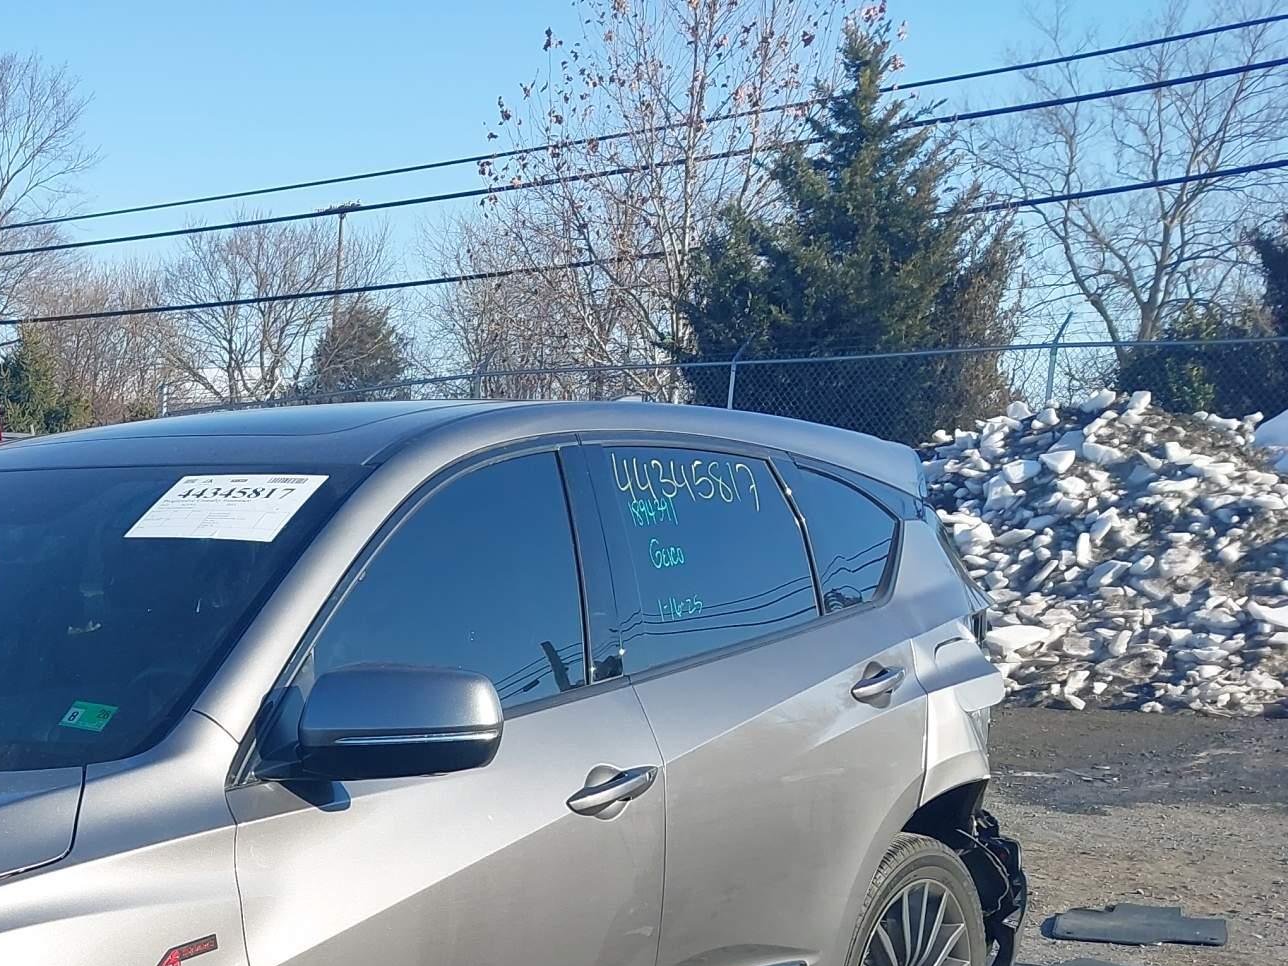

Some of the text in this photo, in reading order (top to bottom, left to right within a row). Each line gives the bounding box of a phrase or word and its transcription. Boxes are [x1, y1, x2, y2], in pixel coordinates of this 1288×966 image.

[611, 453, 760, 512] 44345817
[177, 487, 297, 500] 44345817
[68, 711, 79, 721] 8
